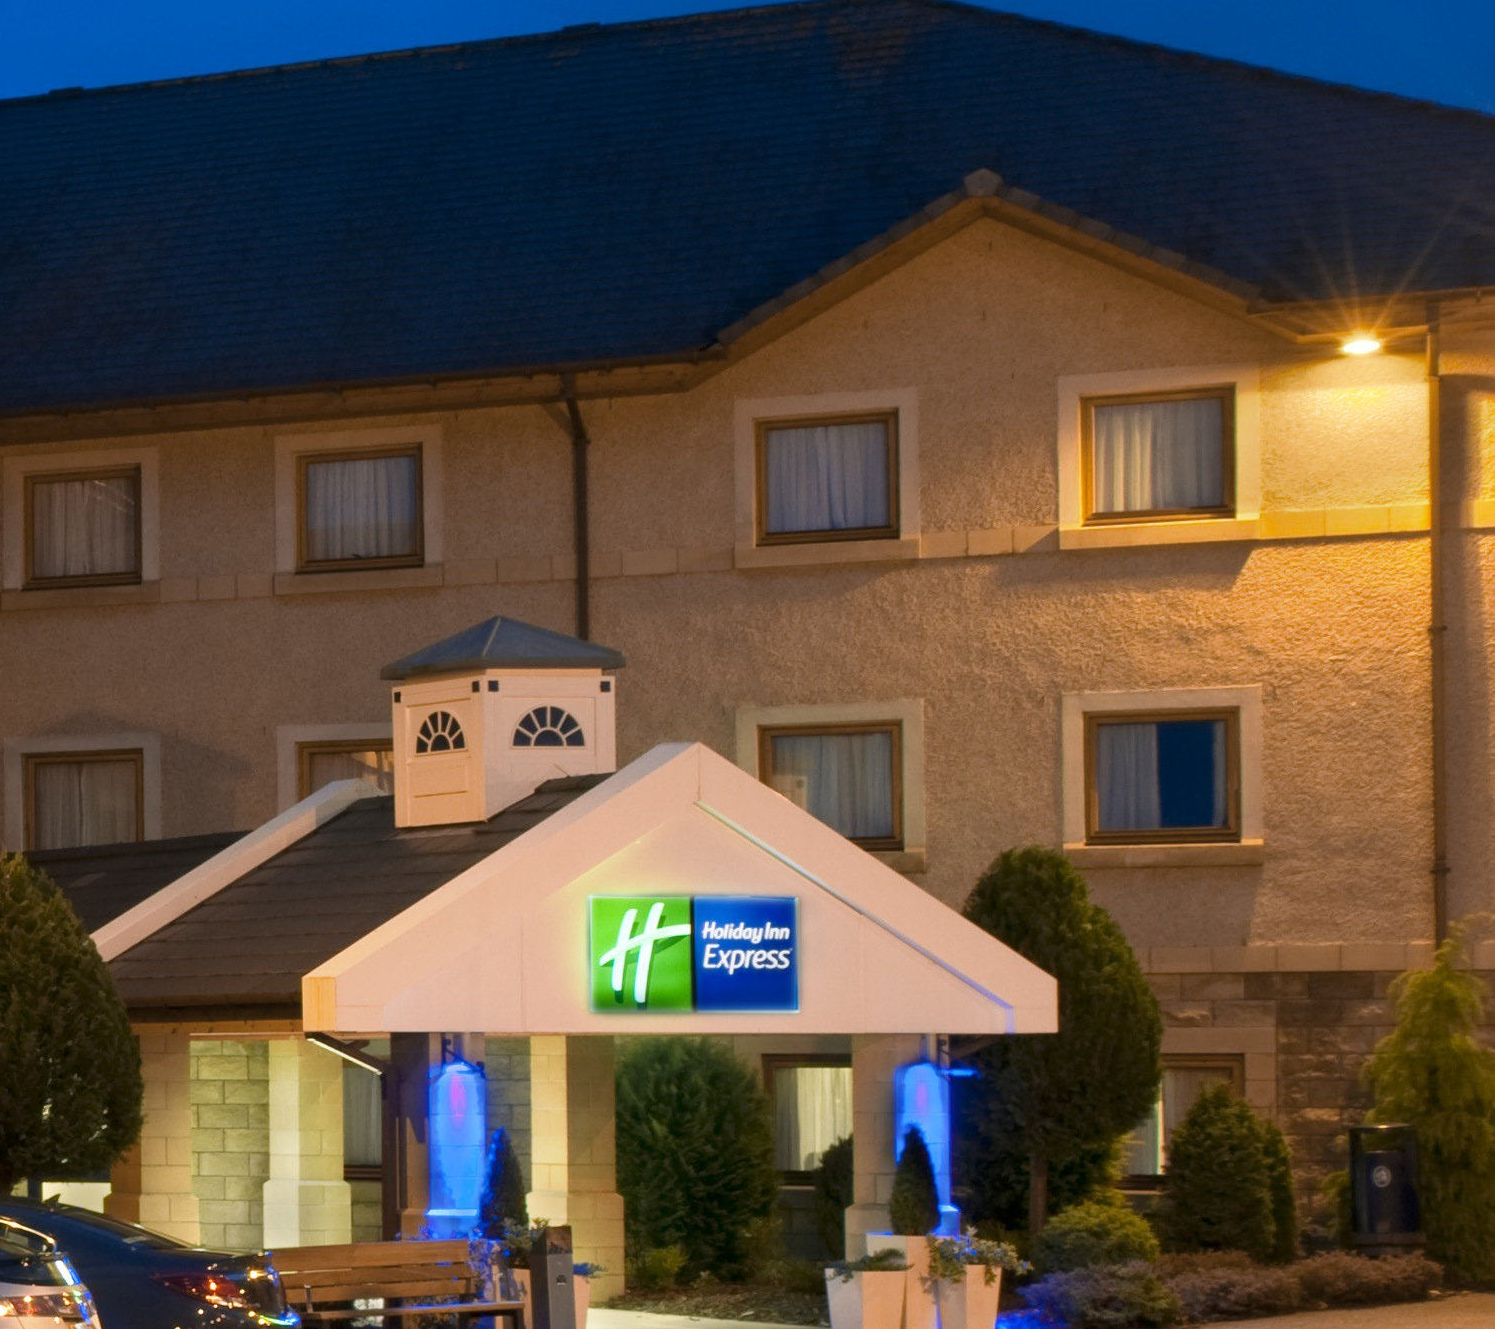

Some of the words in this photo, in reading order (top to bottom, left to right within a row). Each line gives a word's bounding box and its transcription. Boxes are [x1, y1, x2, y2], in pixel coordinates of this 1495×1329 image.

[702, 921, 764, 944] Holiday
[764, 921, 791, 940] Inn
[702, 943, 791, 975] Express
